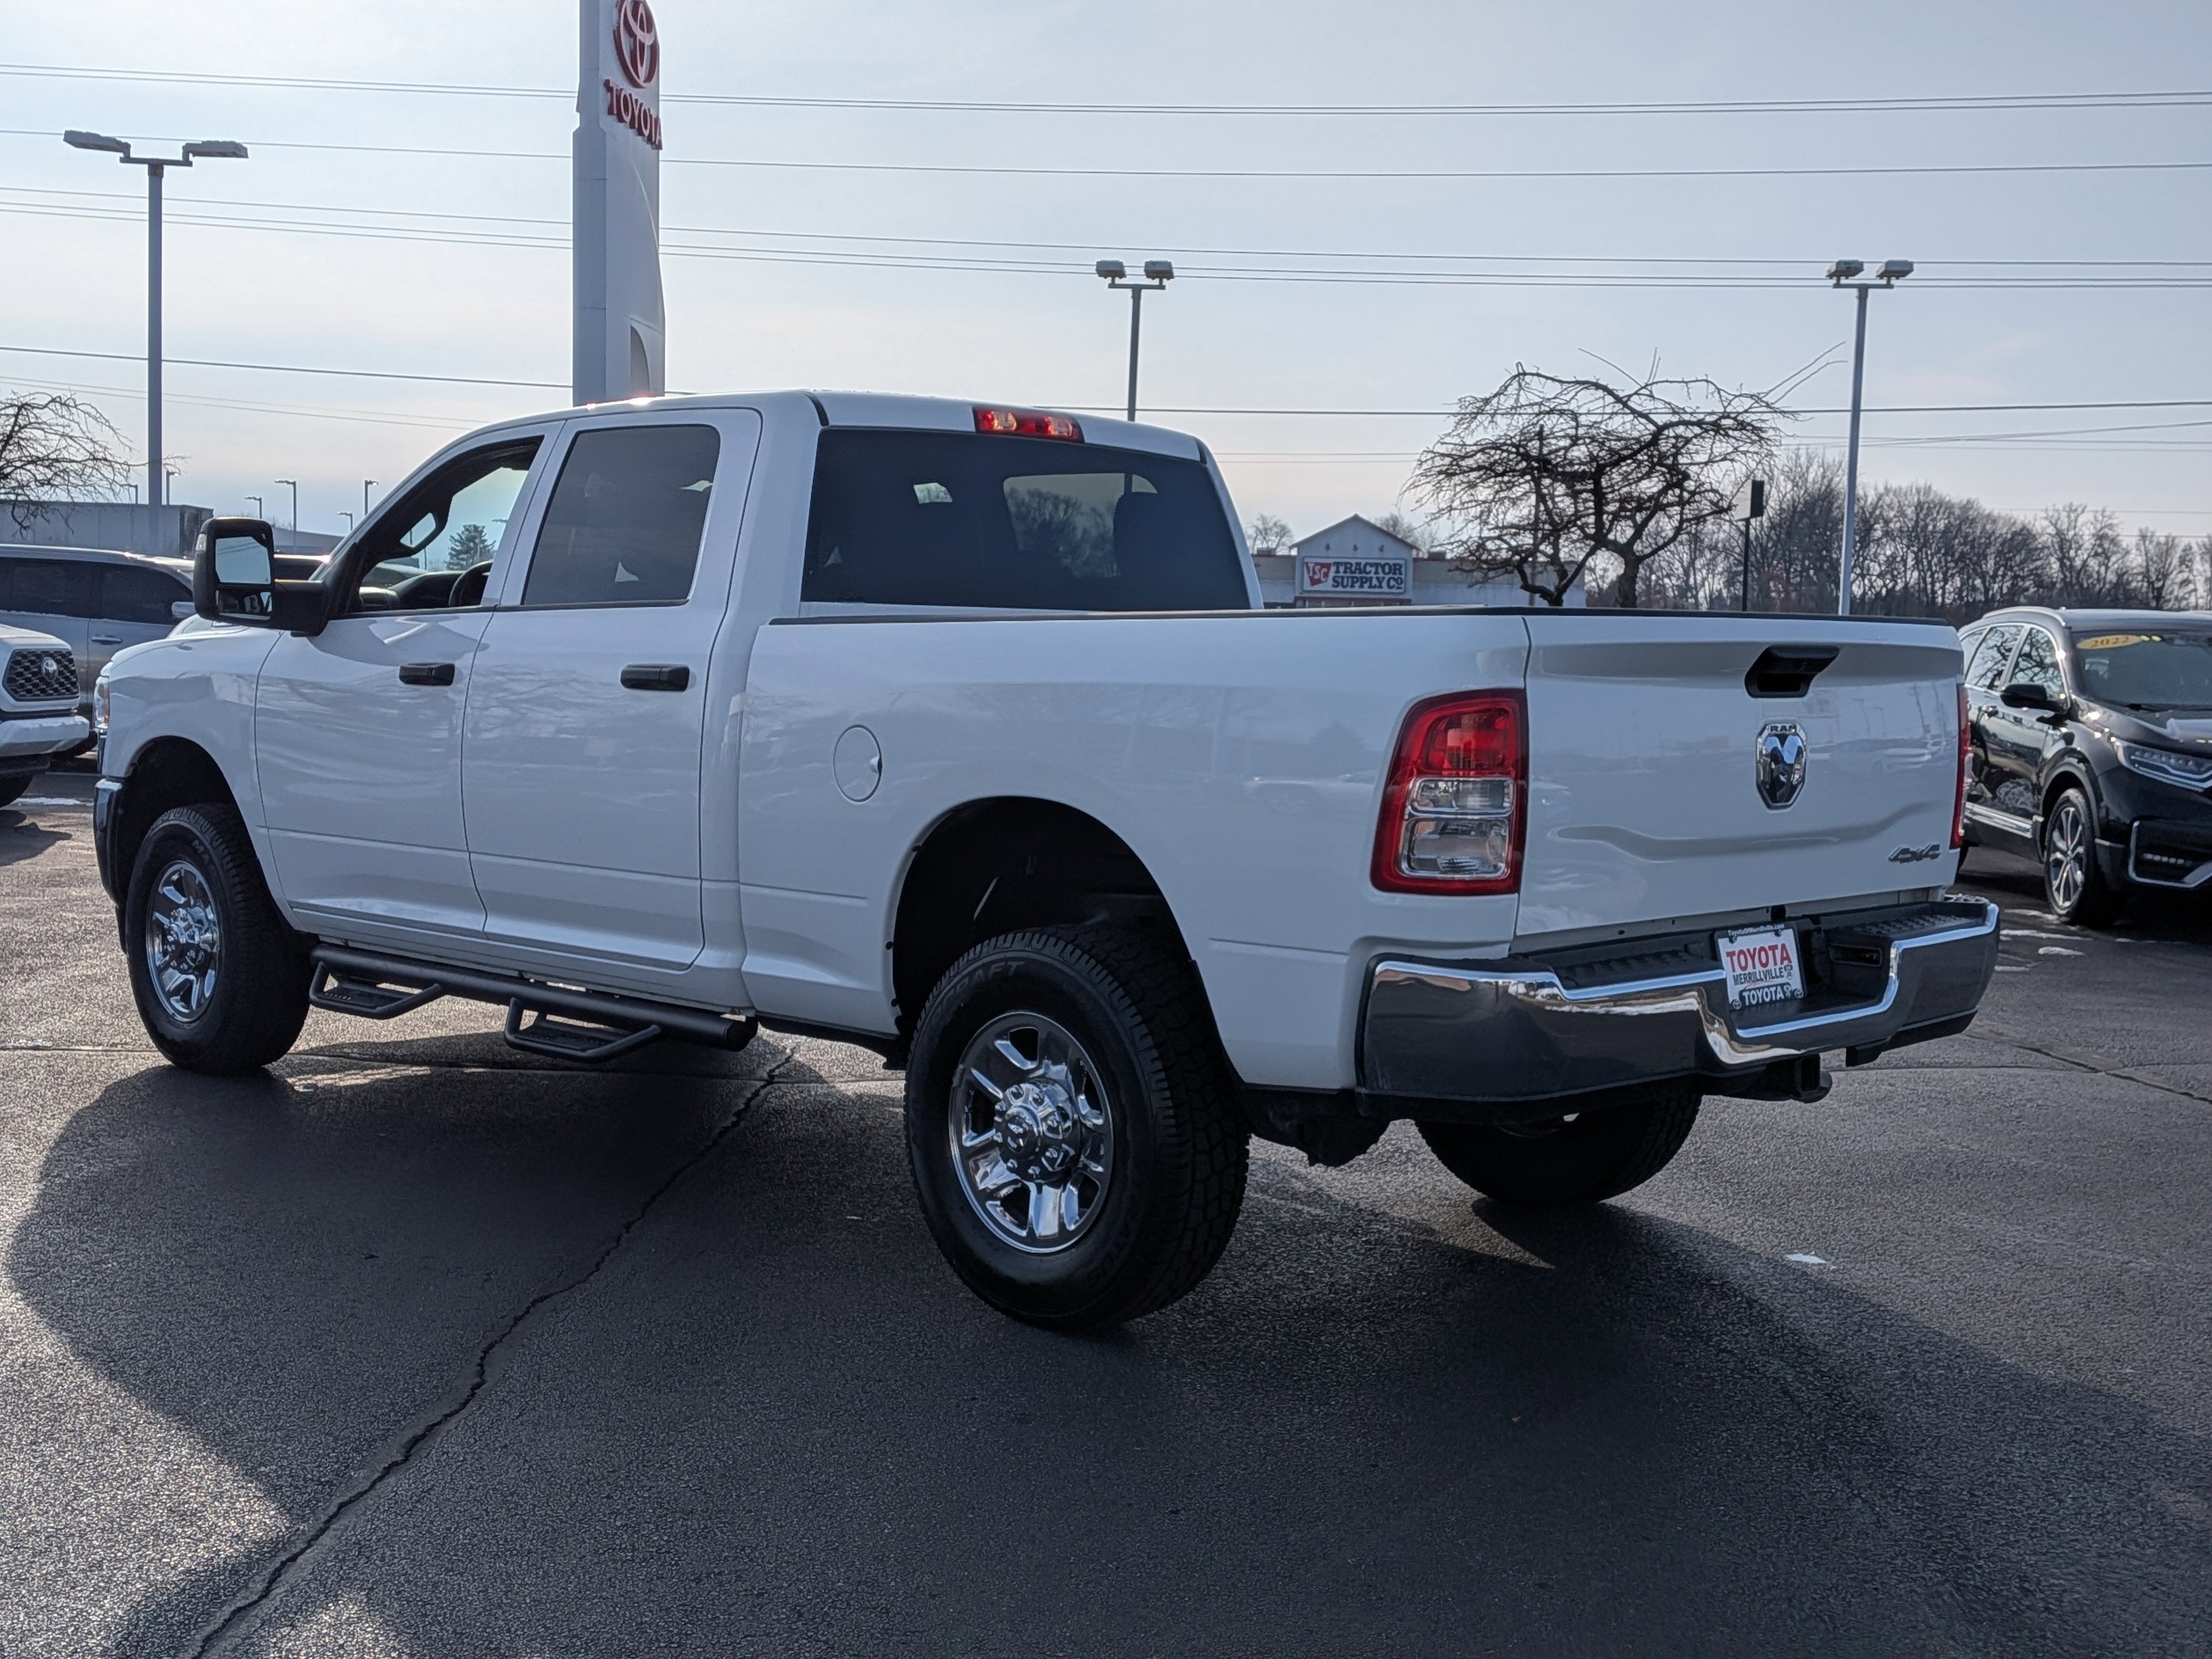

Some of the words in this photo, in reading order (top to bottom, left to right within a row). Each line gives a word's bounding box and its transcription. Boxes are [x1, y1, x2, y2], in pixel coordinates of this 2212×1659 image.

[603, 79, 663, 150] TOYOTA
[1308, 563, 1327, 581] TSC
[1332, 562, 1403, 575] TRACTOR
[1332, 575, 1384, 589] SUPPLY
[1726, 943, 1792, 973] TOYOTA
[1733, 967, 1785, 986] MERRILLVILLE
[1743, 985, 1785, 1006] TOYOTA
